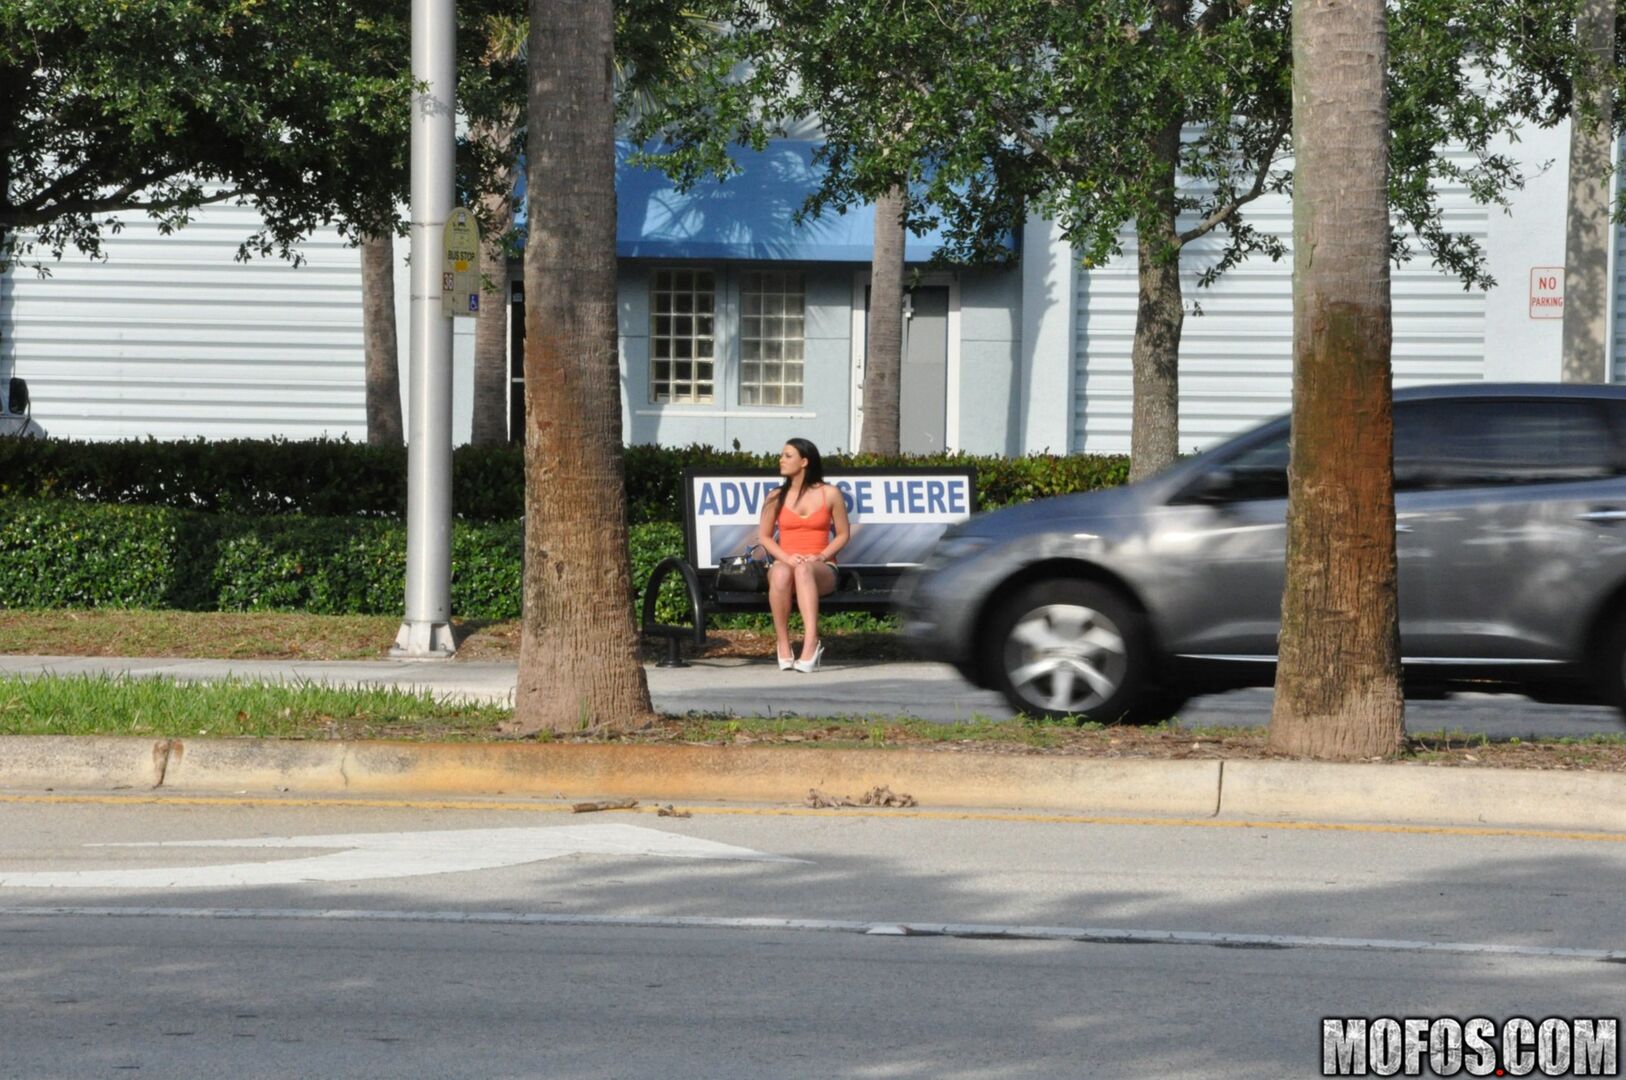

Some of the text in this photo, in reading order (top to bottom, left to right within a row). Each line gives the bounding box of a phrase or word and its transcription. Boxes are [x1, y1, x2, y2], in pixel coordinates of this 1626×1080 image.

[448, 250, 475, 261] BUS STOP
[1539, 277, 1556, 290] NO
[1531, 297, 1563, 307] PARKING
[698, 480, 966, 515] ADVSE HERE
